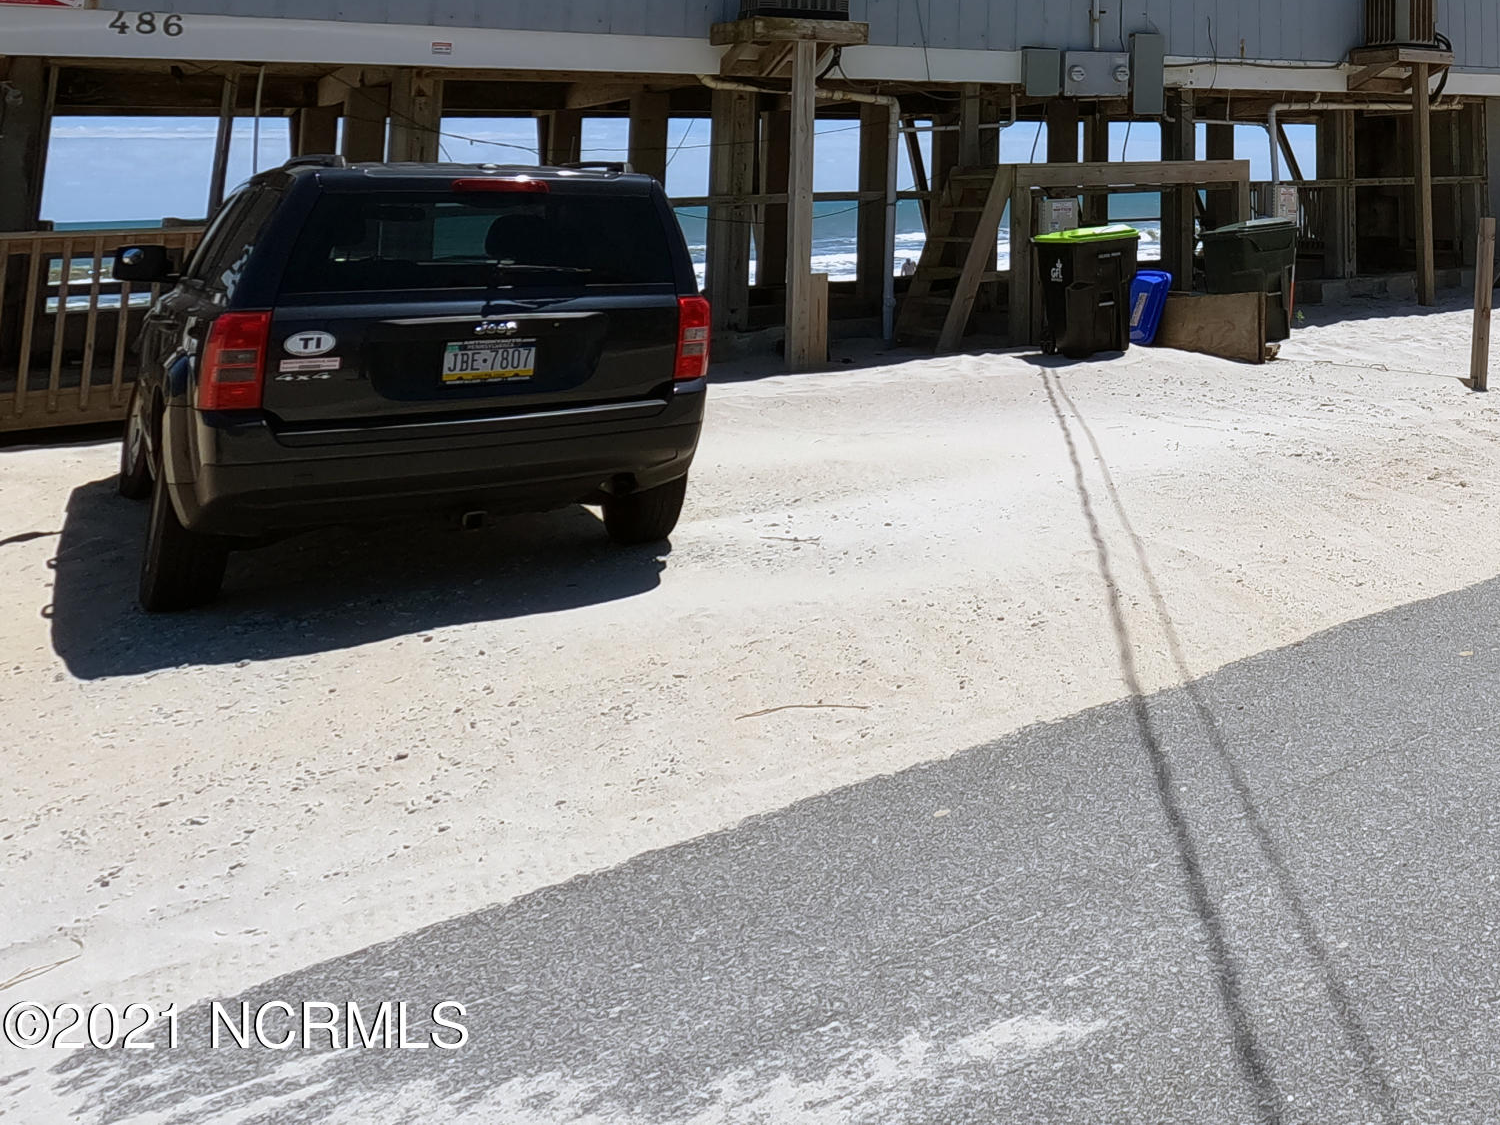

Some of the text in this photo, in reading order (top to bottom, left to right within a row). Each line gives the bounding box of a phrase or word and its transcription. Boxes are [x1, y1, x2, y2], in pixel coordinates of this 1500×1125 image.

[108, 10, 183, 37] 486
[1050, 267, 1063, 279] GFL
[474, 321, 518, 335] Jeep
[299, 336, 322, 350] TI
